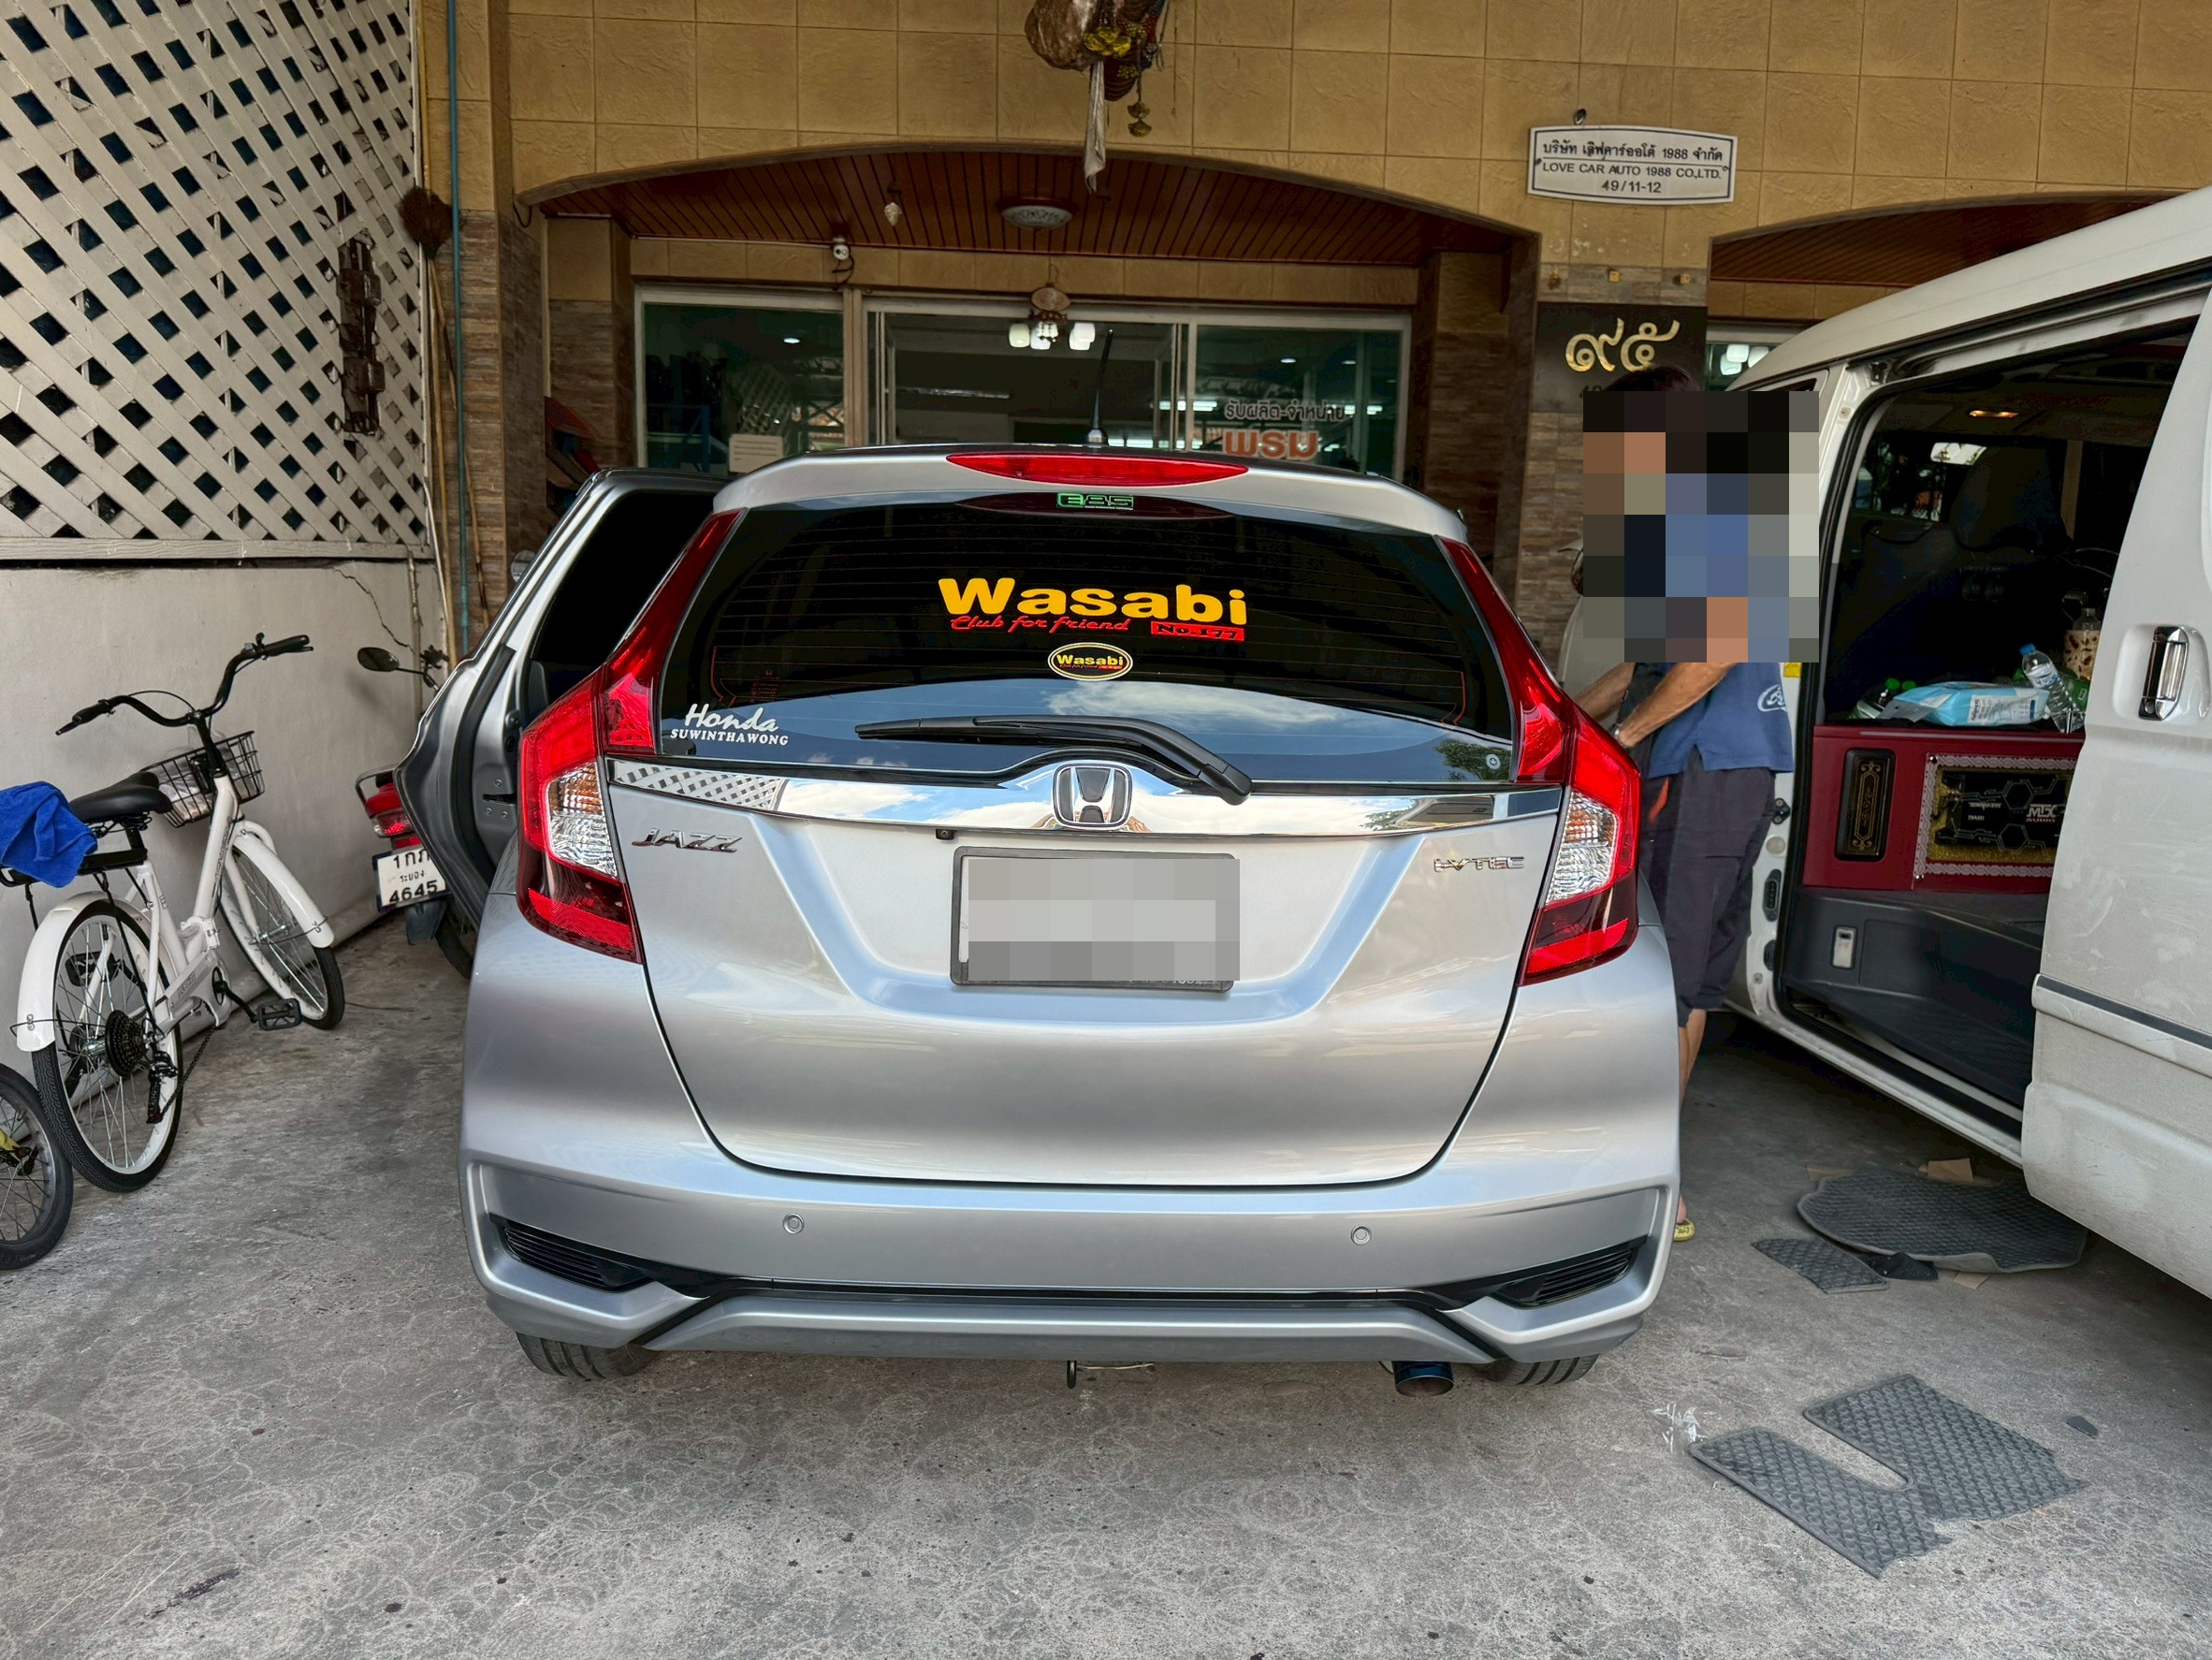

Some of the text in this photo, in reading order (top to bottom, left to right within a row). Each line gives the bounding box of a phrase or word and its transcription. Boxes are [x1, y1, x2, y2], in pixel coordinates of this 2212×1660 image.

[1542, 138, 1578, 155] บริษัท
[1662, 148, 1688, 160] 1988
[1693, 147, 1723, 161] จำกัด
[1542, 162, 1575, 173] LOVE
[1579, 163, 1605, 174] CAR
[1608, 165, 1641, 176] AUTO
[1646, 167, 1671, 178] 1988
[1601, 180, 1662, 194] 49/11-12
[1222, 429, 1318, 461] พรม
[938, 577, 1247, 625] Wasabi
[950, 615, 1131, 633] Club for friend
[1056, 654, 1124, 666] Wasabi
[684, 703, 779, 733] Honda
[670, 728, 790, 746] SUWINTHAWONG
[2026, 803, 2058, 819] MTX
[631, 827, 743, 853] JAZZ
[400, 869, 425, 882] ระยอง
[389, 880, 438, 903] 4645
